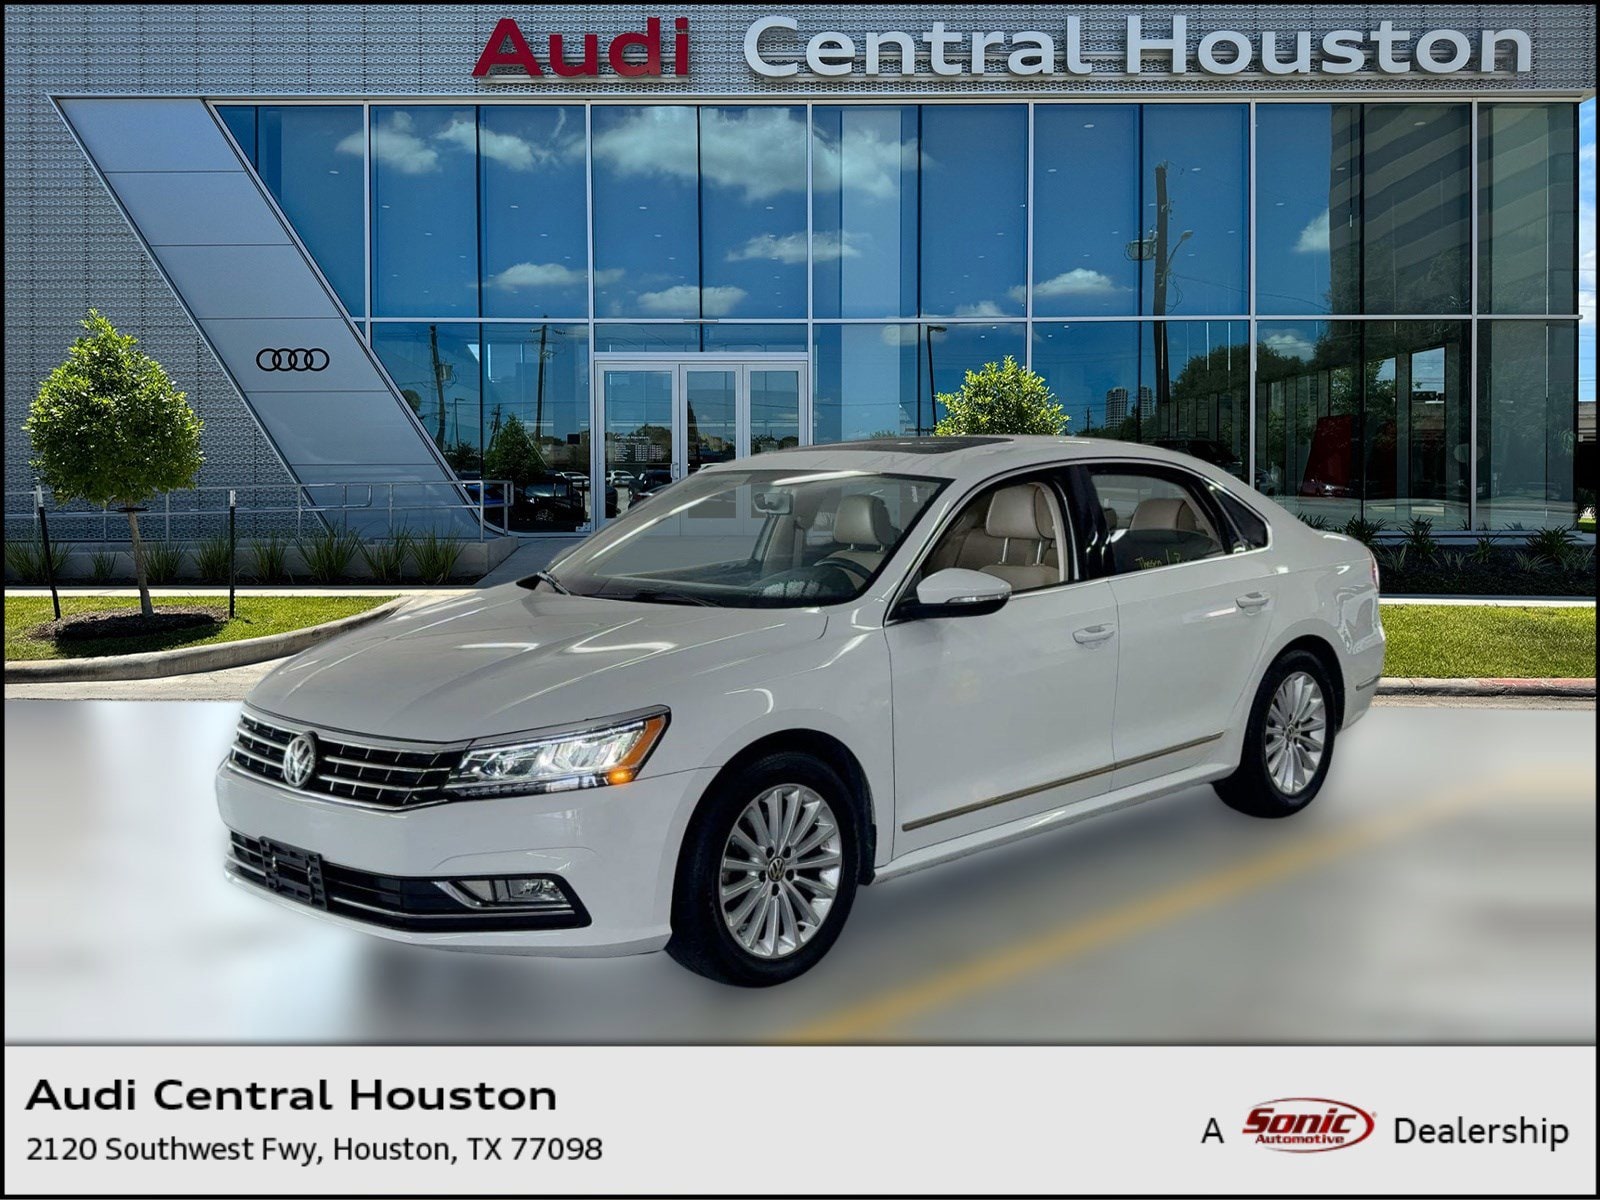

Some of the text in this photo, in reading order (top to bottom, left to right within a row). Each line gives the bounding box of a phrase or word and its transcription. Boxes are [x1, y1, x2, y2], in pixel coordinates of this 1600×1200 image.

[471, 15, 1532, 78] Audi Central Houston
